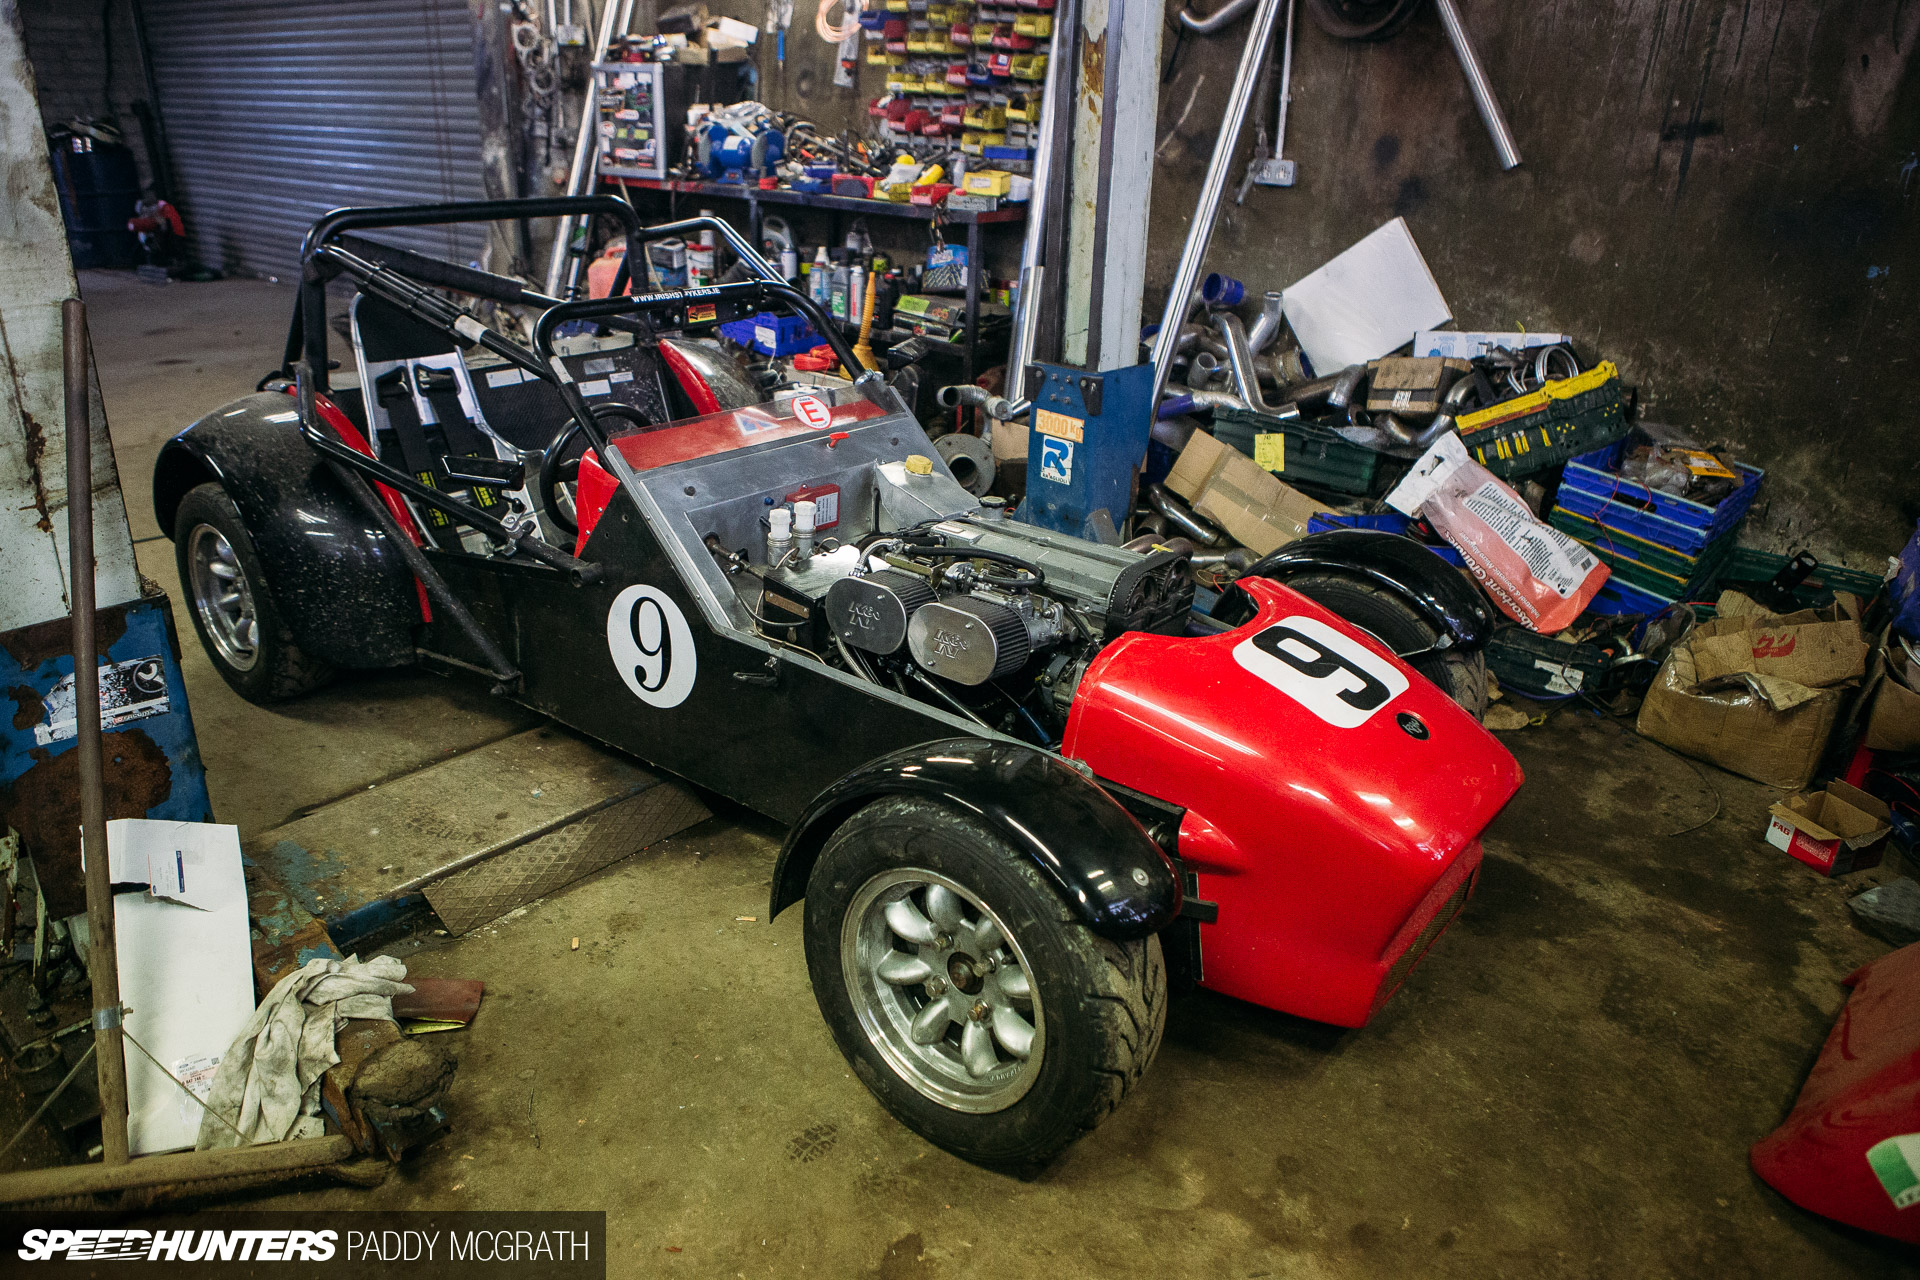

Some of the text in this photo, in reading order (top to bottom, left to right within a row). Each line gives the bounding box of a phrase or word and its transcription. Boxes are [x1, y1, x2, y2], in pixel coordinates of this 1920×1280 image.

[799, 400, 825, 423] E
[1038, 412, 1081, 440] 3000 kg
[1479, 551, 1496, 569] Micro
[1492, 566, 1516, 593] Domestic
[1483, 578, 1539, 632] Absorbent
[1518, 594, 1541, 620] Industrial
[629, 596, 672, 693] 9
[1251, 625, 1392, 711] 9
[1772, 821, 1791, 836] FAG
